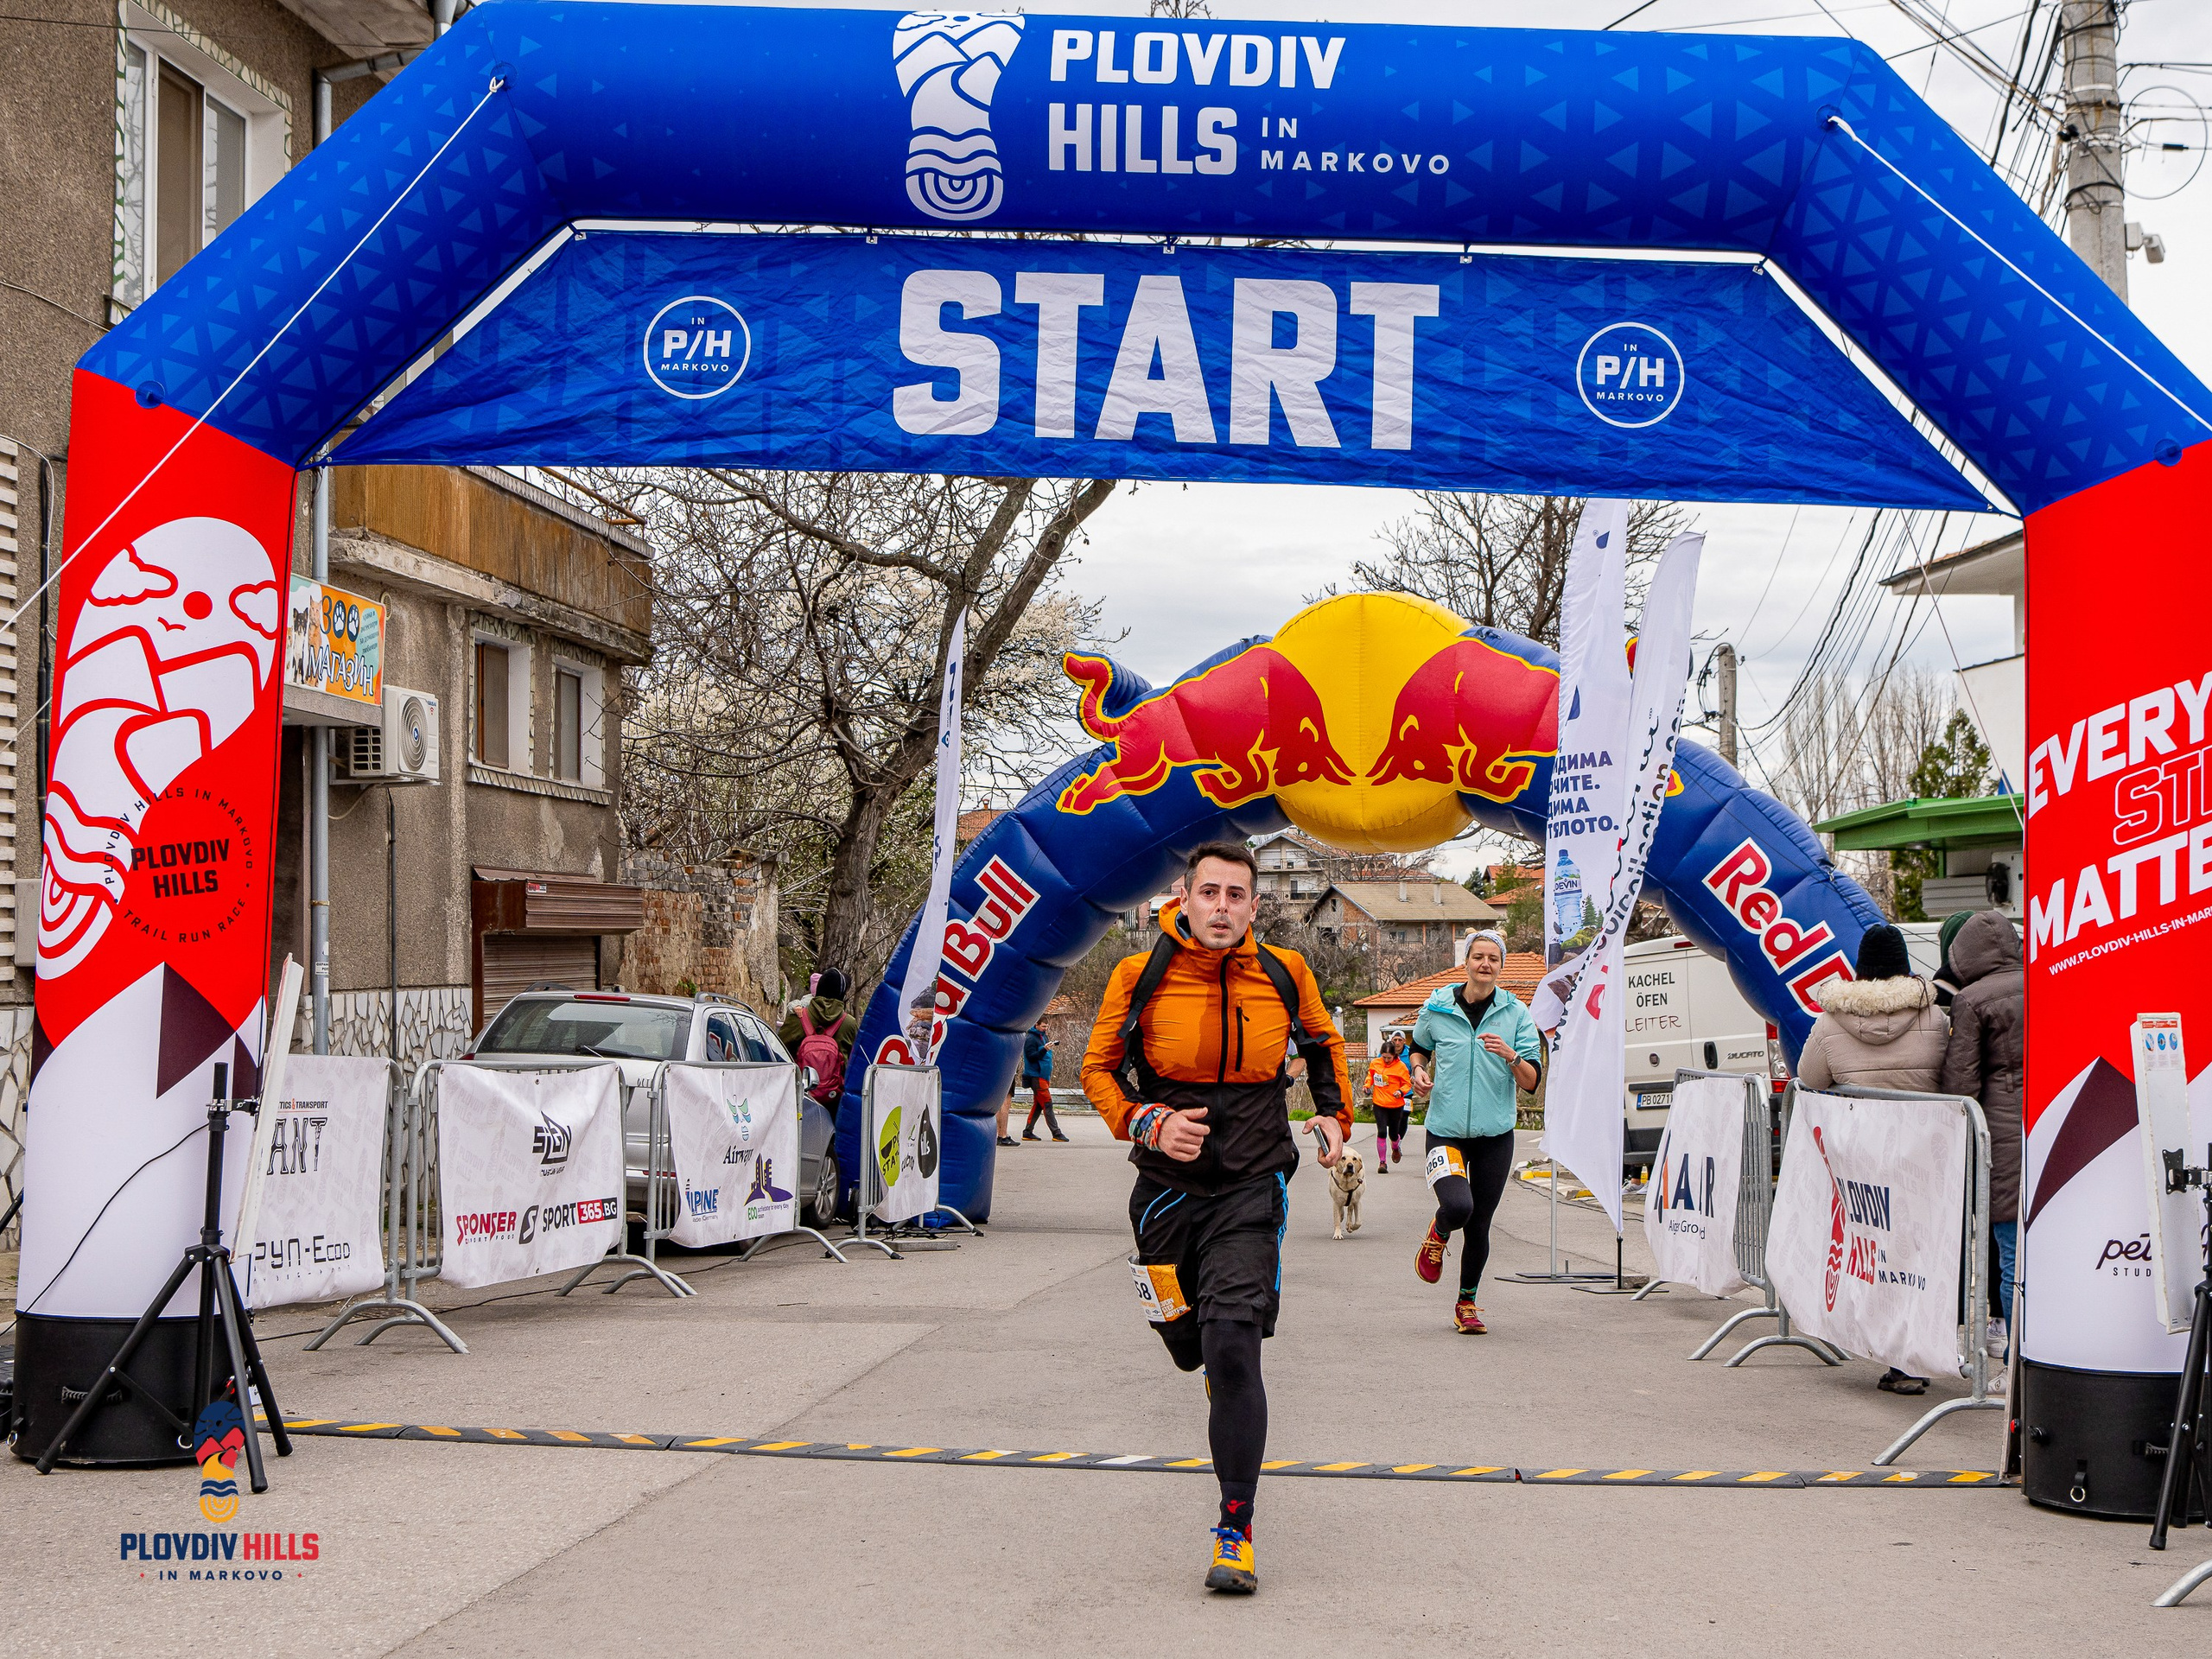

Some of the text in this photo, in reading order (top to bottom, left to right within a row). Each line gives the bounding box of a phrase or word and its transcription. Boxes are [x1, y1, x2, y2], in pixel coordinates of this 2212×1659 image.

[1050, 29, 1346, 89] PLOVDIV
[1047, 103, 1238, 175] HILLS
[1262, 117, 1297, 139] IN
[1261, 150, 1451, 175] MARKOVO
[663, 330, 732, 360] P/H
[892, 269, 1440, 451] START
[1624, 343, 1637, 352] IN
[660, 363, 729, 372] MARKOVO
[1596, 355, 1664, 389] P/H
[1596, 391, 1664, 402] MARKOVO
[308, 645, 374, 696] МАГАЗИН
[2029, 671, 2212, 819] EVERY
[2113, 745, 2212, 845] ST
[104, 787, 253, 884] PLOVDIV HILLS IN MARKOVO
[1548, 815, 1619, 840] ТЯЛОТО.
[130, 838, 230, 871] PLOVDIV
[153, 869, 219, 899] HILLS
[1555, 880, 1578, 890] DEVIN
[124, 899, 245, 943] TRAIL RUN RACE
[942, 860, 1035, 976] Bull
[1707, 842, 1829, 969] Red
[2049, 906, 2212, 976] WWW.PLOVDIV-HILLS-IN-MAR
[1628, 972, 1675, 988] KACHEL
[1637, 992, 1668, 1007] ÖFEN
[1625, 1014, 1681, 1032] LEITER
[1728, 1051, 1764, 1059] DUCATO
[456, 1211, 517, 1246] SPONSER
[1878, 1249, 1886, 1263] IN
